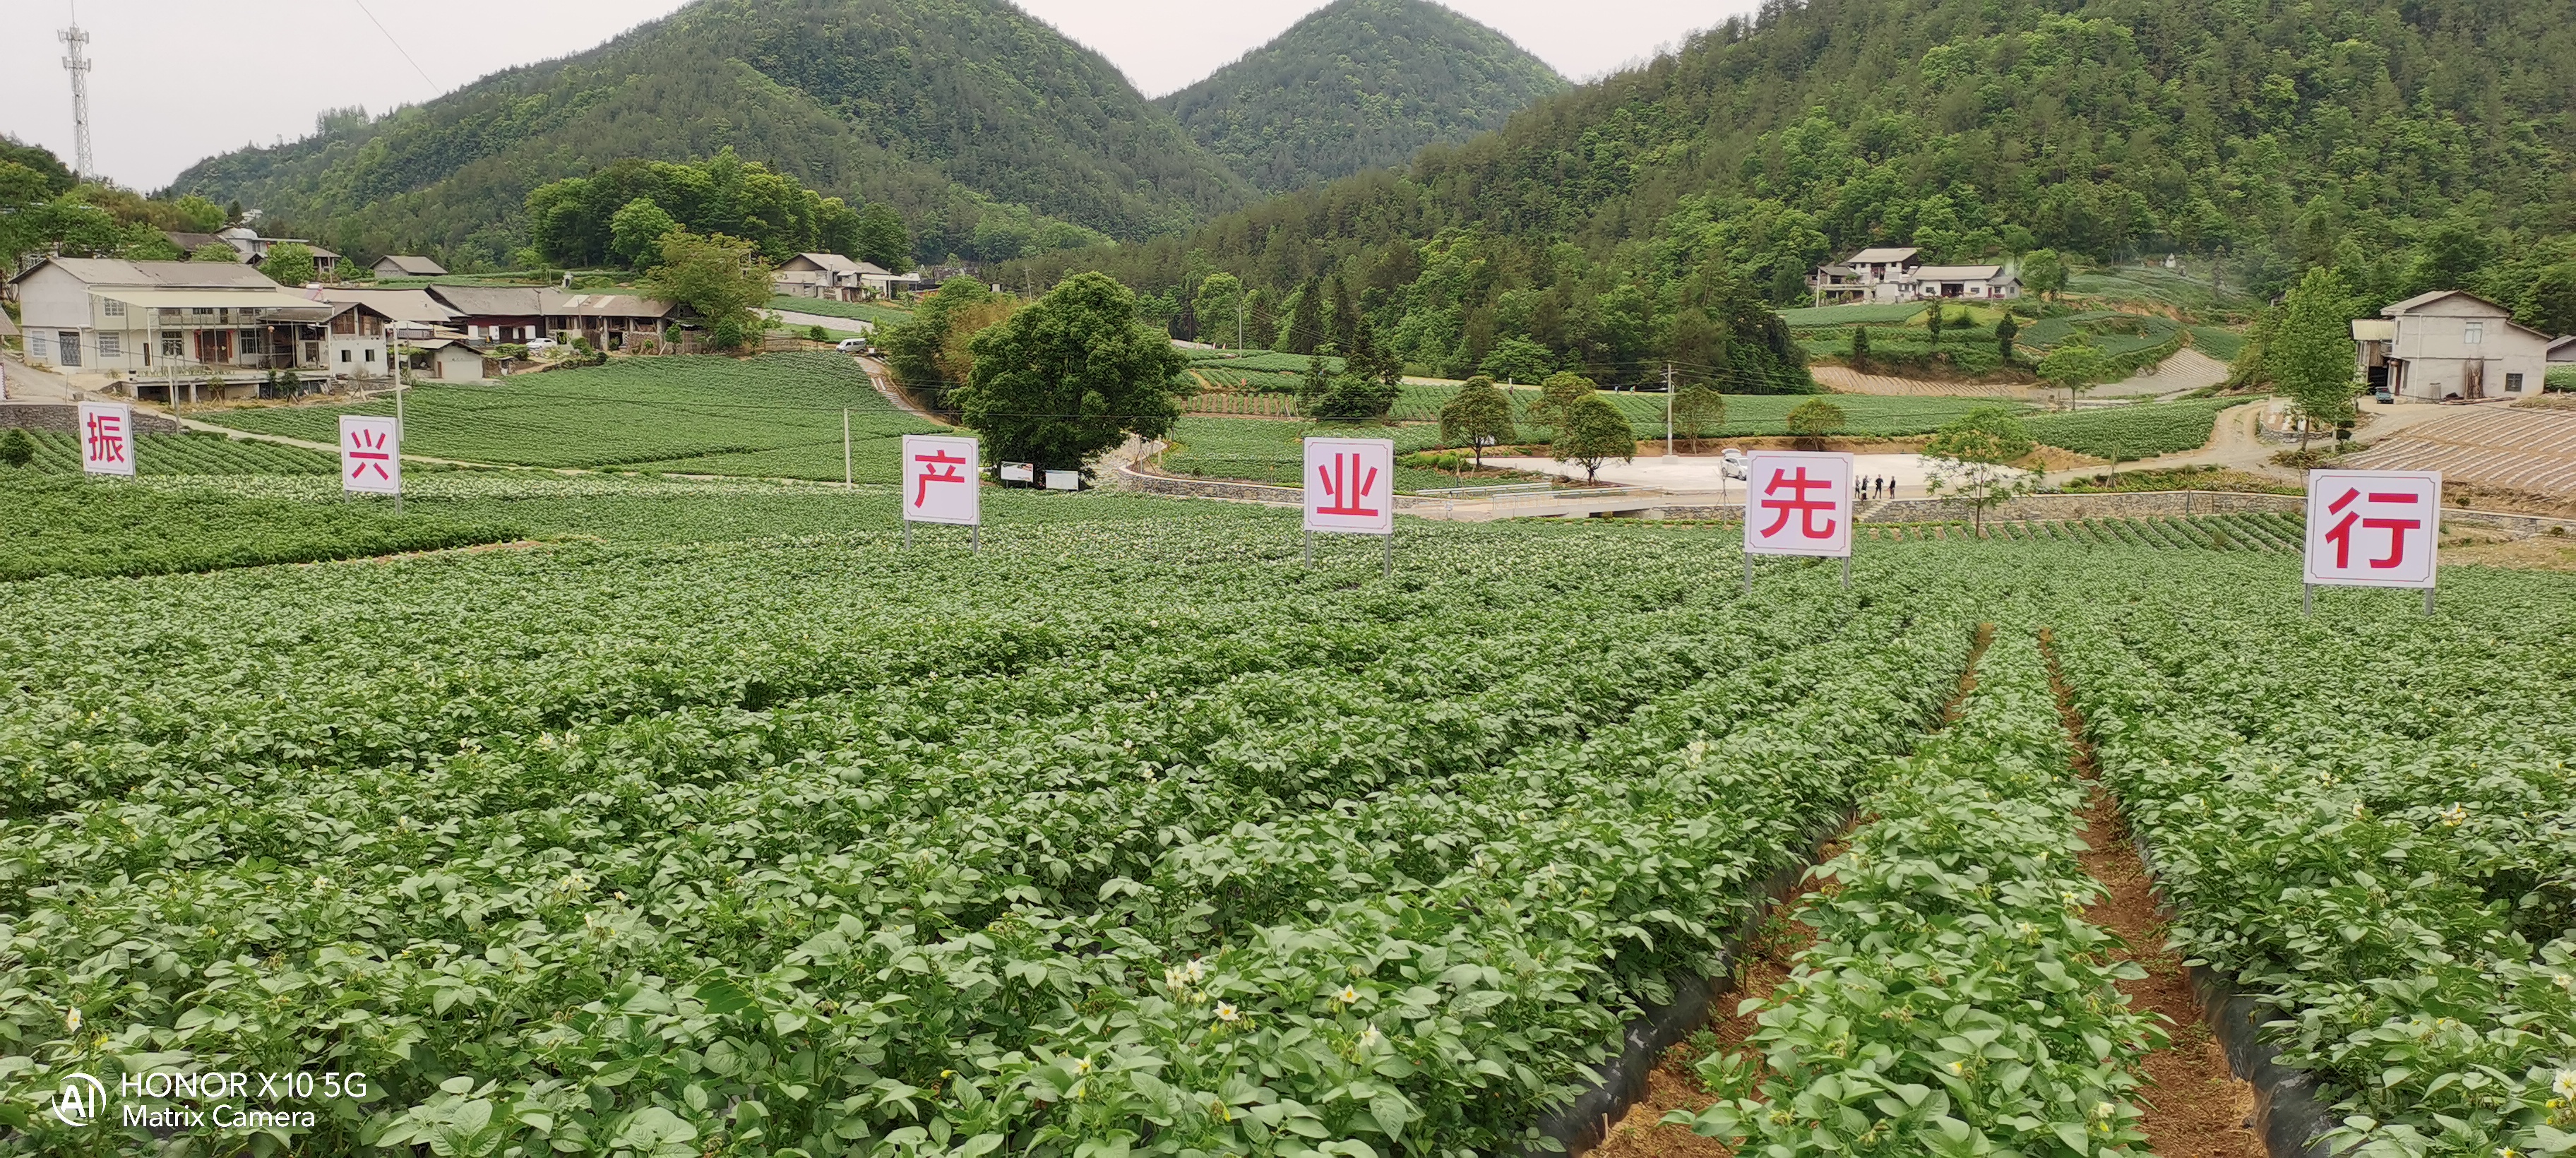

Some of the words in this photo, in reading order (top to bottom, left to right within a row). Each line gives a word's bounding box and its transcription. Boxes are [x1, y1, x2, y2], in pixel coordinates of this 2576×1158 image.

[88, 412, 125, 462] 振
[350, 429, 390, 481] 兴
[914, 450, 967, 508] 产
[1316, 453, 1379, 518] 业
[1760, 467, 1837, 540] 先
[2325, 488, 2421, 570] 行
